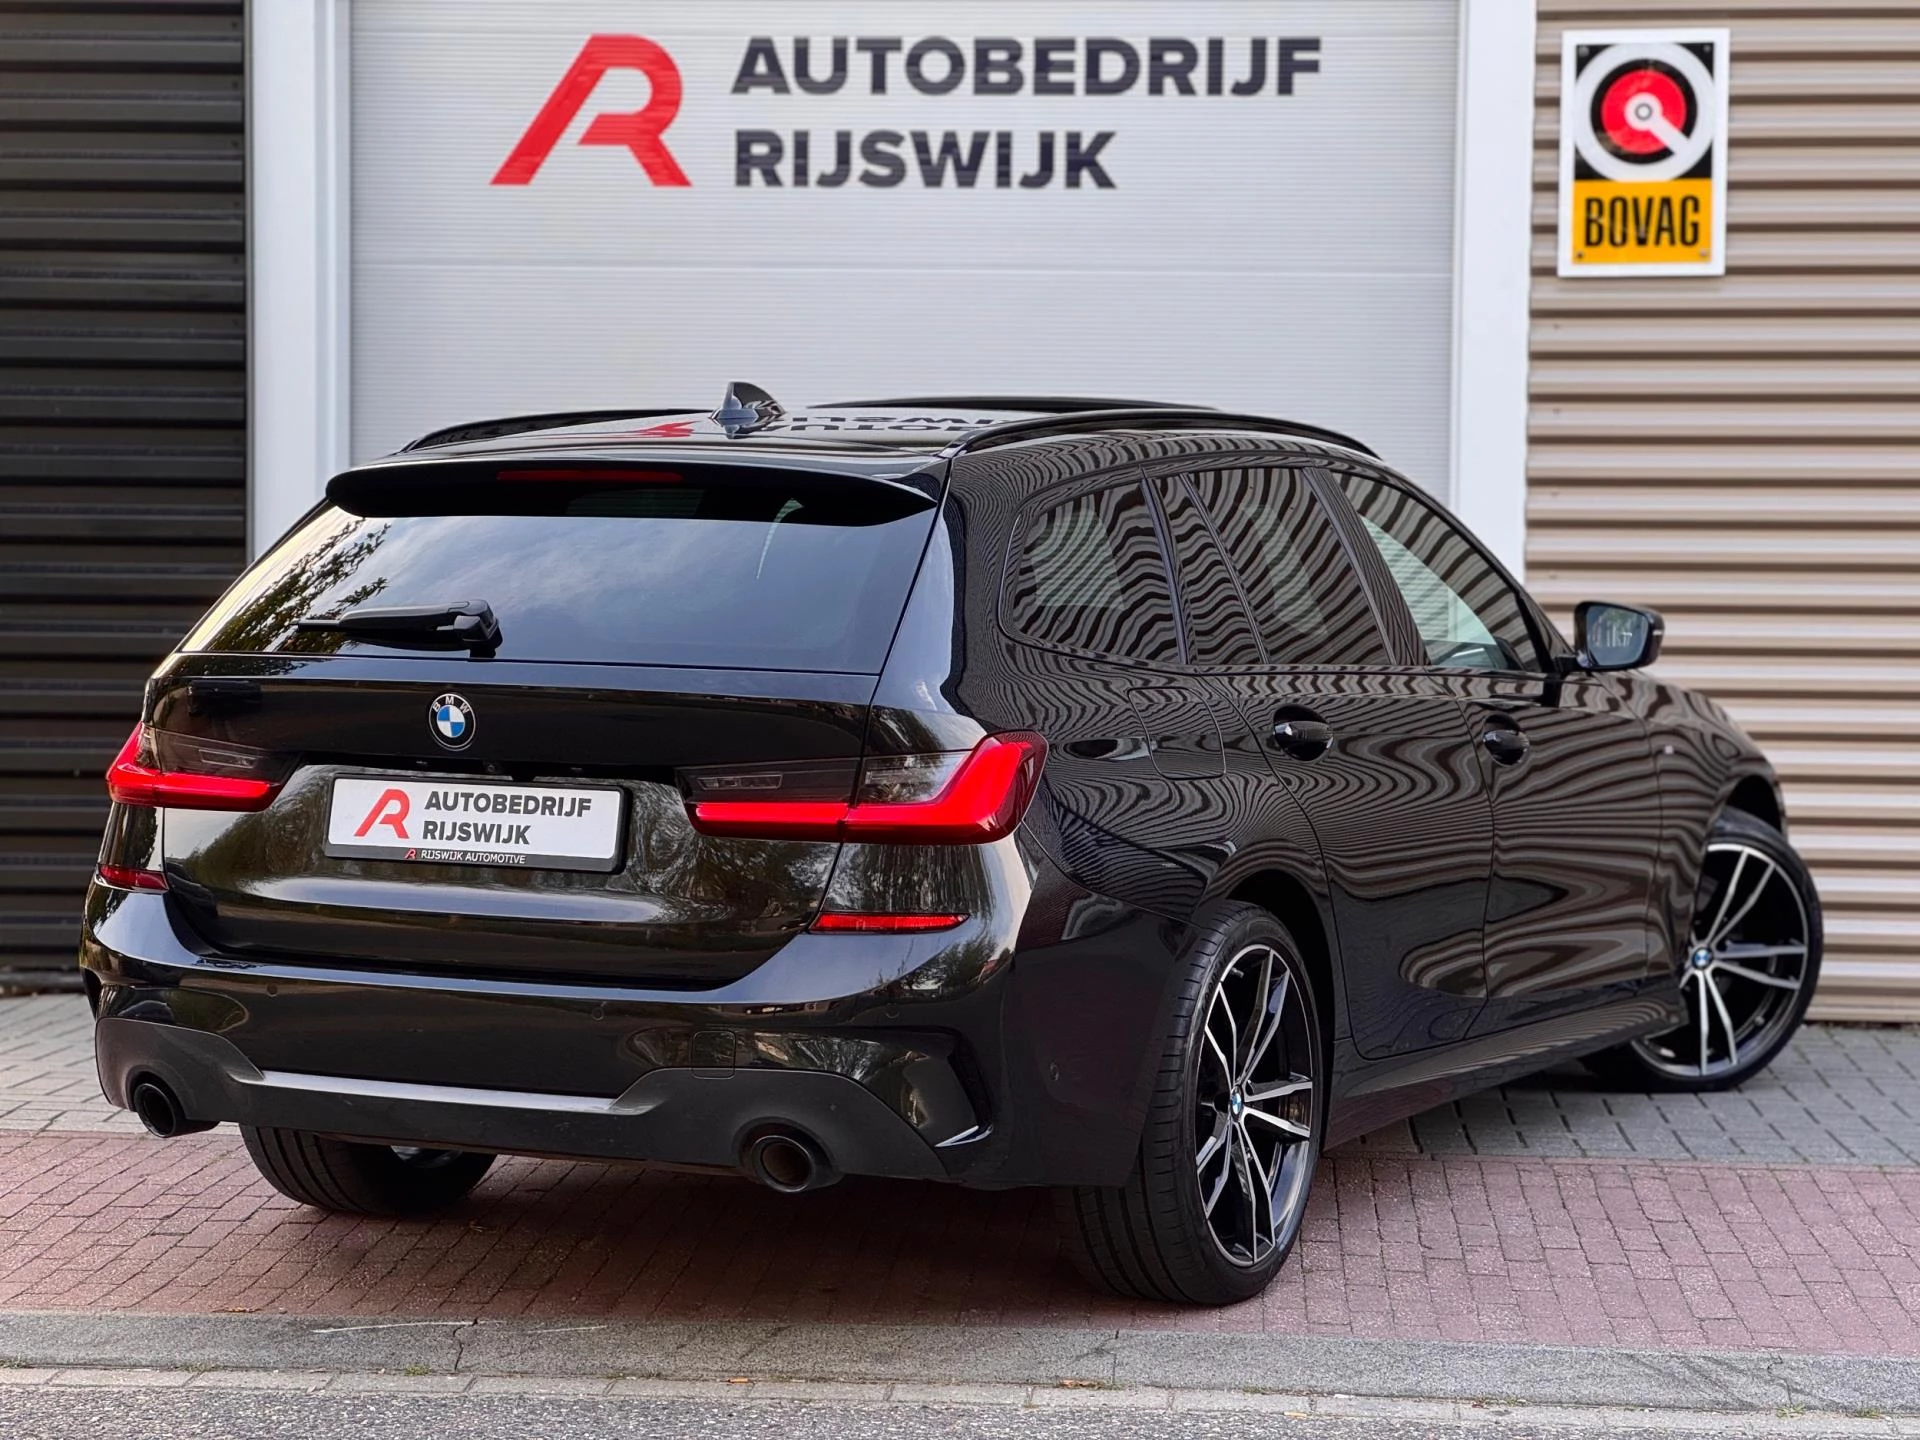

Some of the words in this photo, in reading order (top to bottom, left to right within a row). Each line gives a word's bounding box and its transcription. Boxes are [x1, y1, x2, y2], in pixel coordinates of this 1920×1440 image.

[731, 37, 1321, 96] AUTOBEDRIJF
[734, 129, 1117, 189] RIJSWIJK
[1584, 195, 1700, 248] BOVAG
[432, 695, 470, 714] BMW
[424, 790, 592, 818] AUTOBEDRIJF
[422, 820, 531, 845] RIJSWIJK
[421, 849, 463, 861] RIJSWIJK
[464, 852, 526, 864] AUTOMOTIVE
